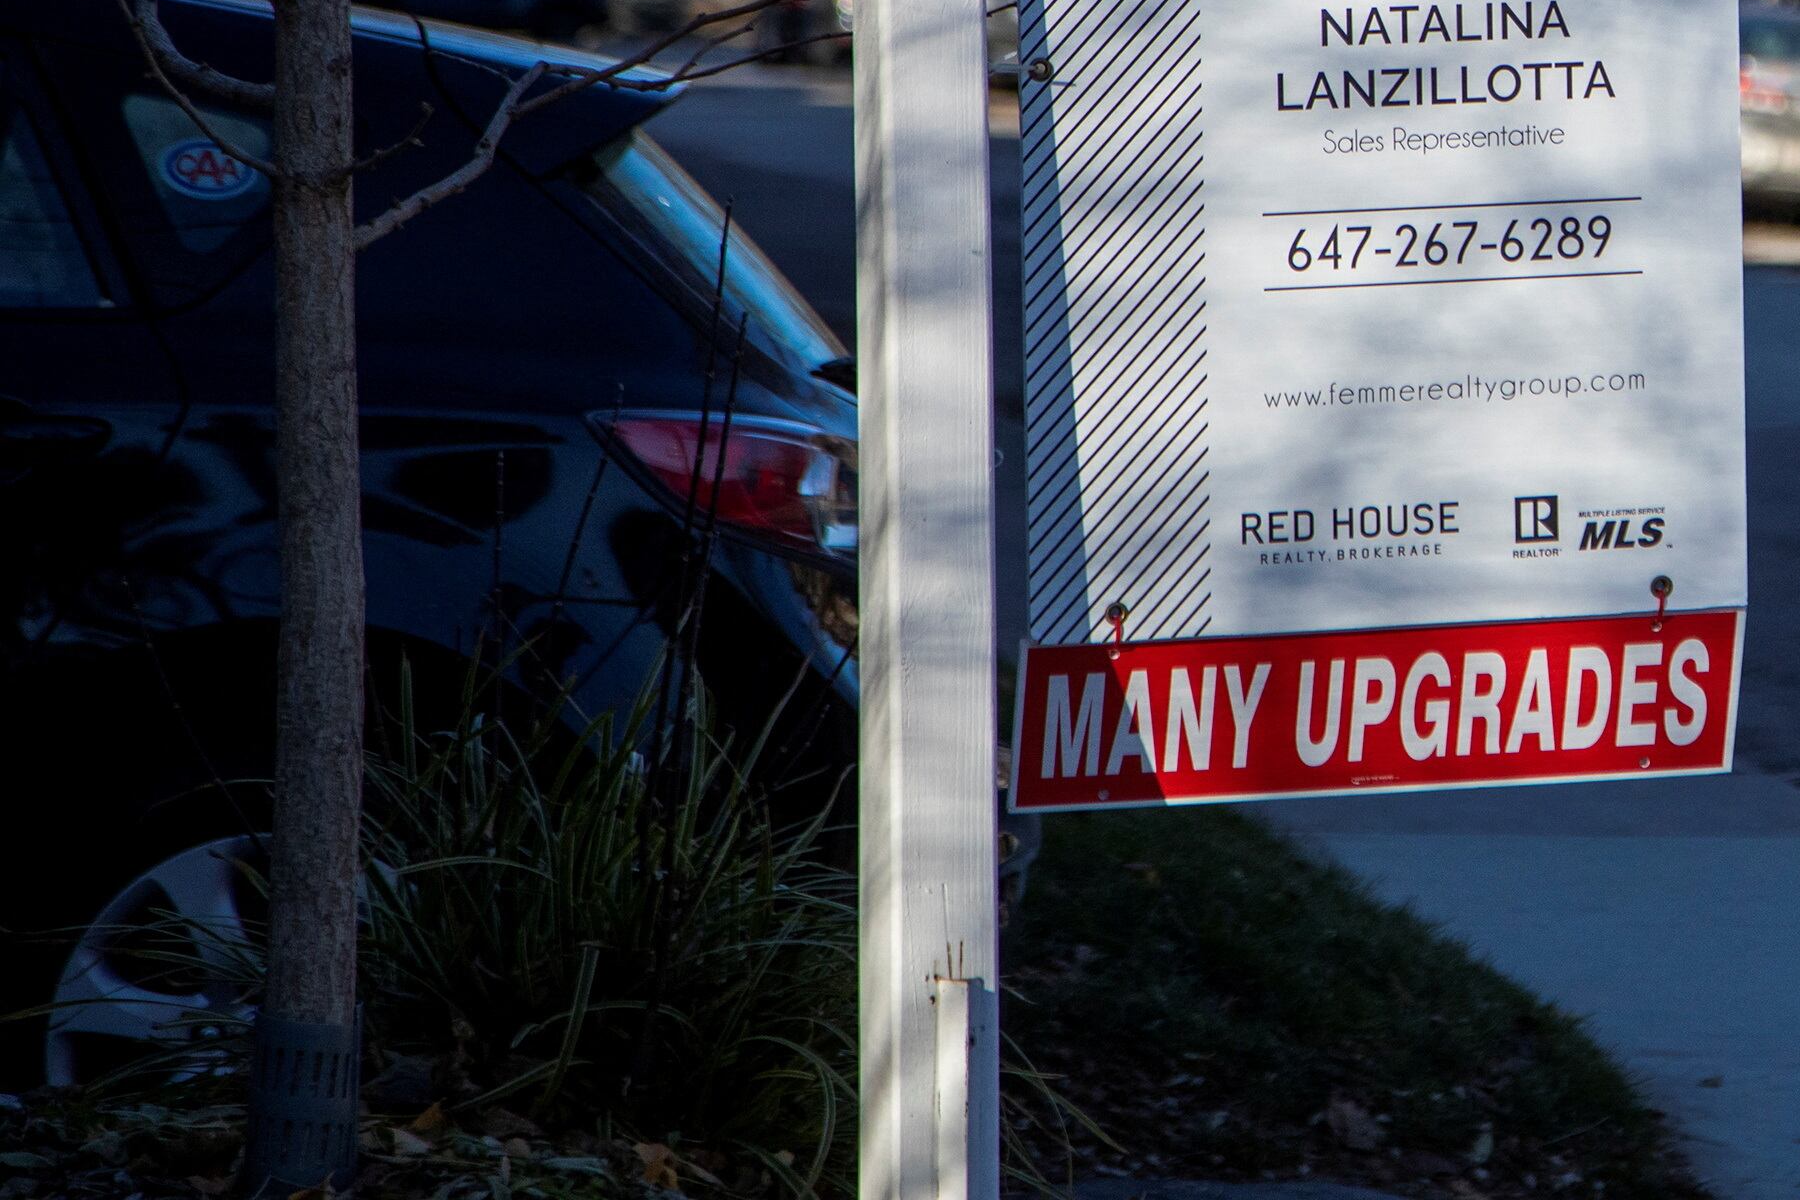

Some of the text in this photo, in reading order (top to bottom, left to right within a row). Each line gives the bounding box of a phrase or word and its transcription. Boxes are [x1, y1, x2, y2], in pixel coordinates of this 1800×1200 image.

[1321, 1, 1570, 46] NATALINA
[1278, 61, 1616, 110] LANZILLOTTA
[1323, 124, 1565, 155] Sales Representative
[176, 150, 237, 185] CAA
[1287, 215, 1612, 272] 647-267-6289
[1264, 373, 1645, 408] www.femmerealtygroup.com
[1242, 502, 1460, 545] RED HOUSE
[1578, 506, 1666, 519] MULTIPLE LISTING SERVICE
[1579, 517, 1666, 551] MLS
[1337, 543, 1442, 561] BROKERAGE
[1043, 638, 1711, 778] MANY UPGRADES
